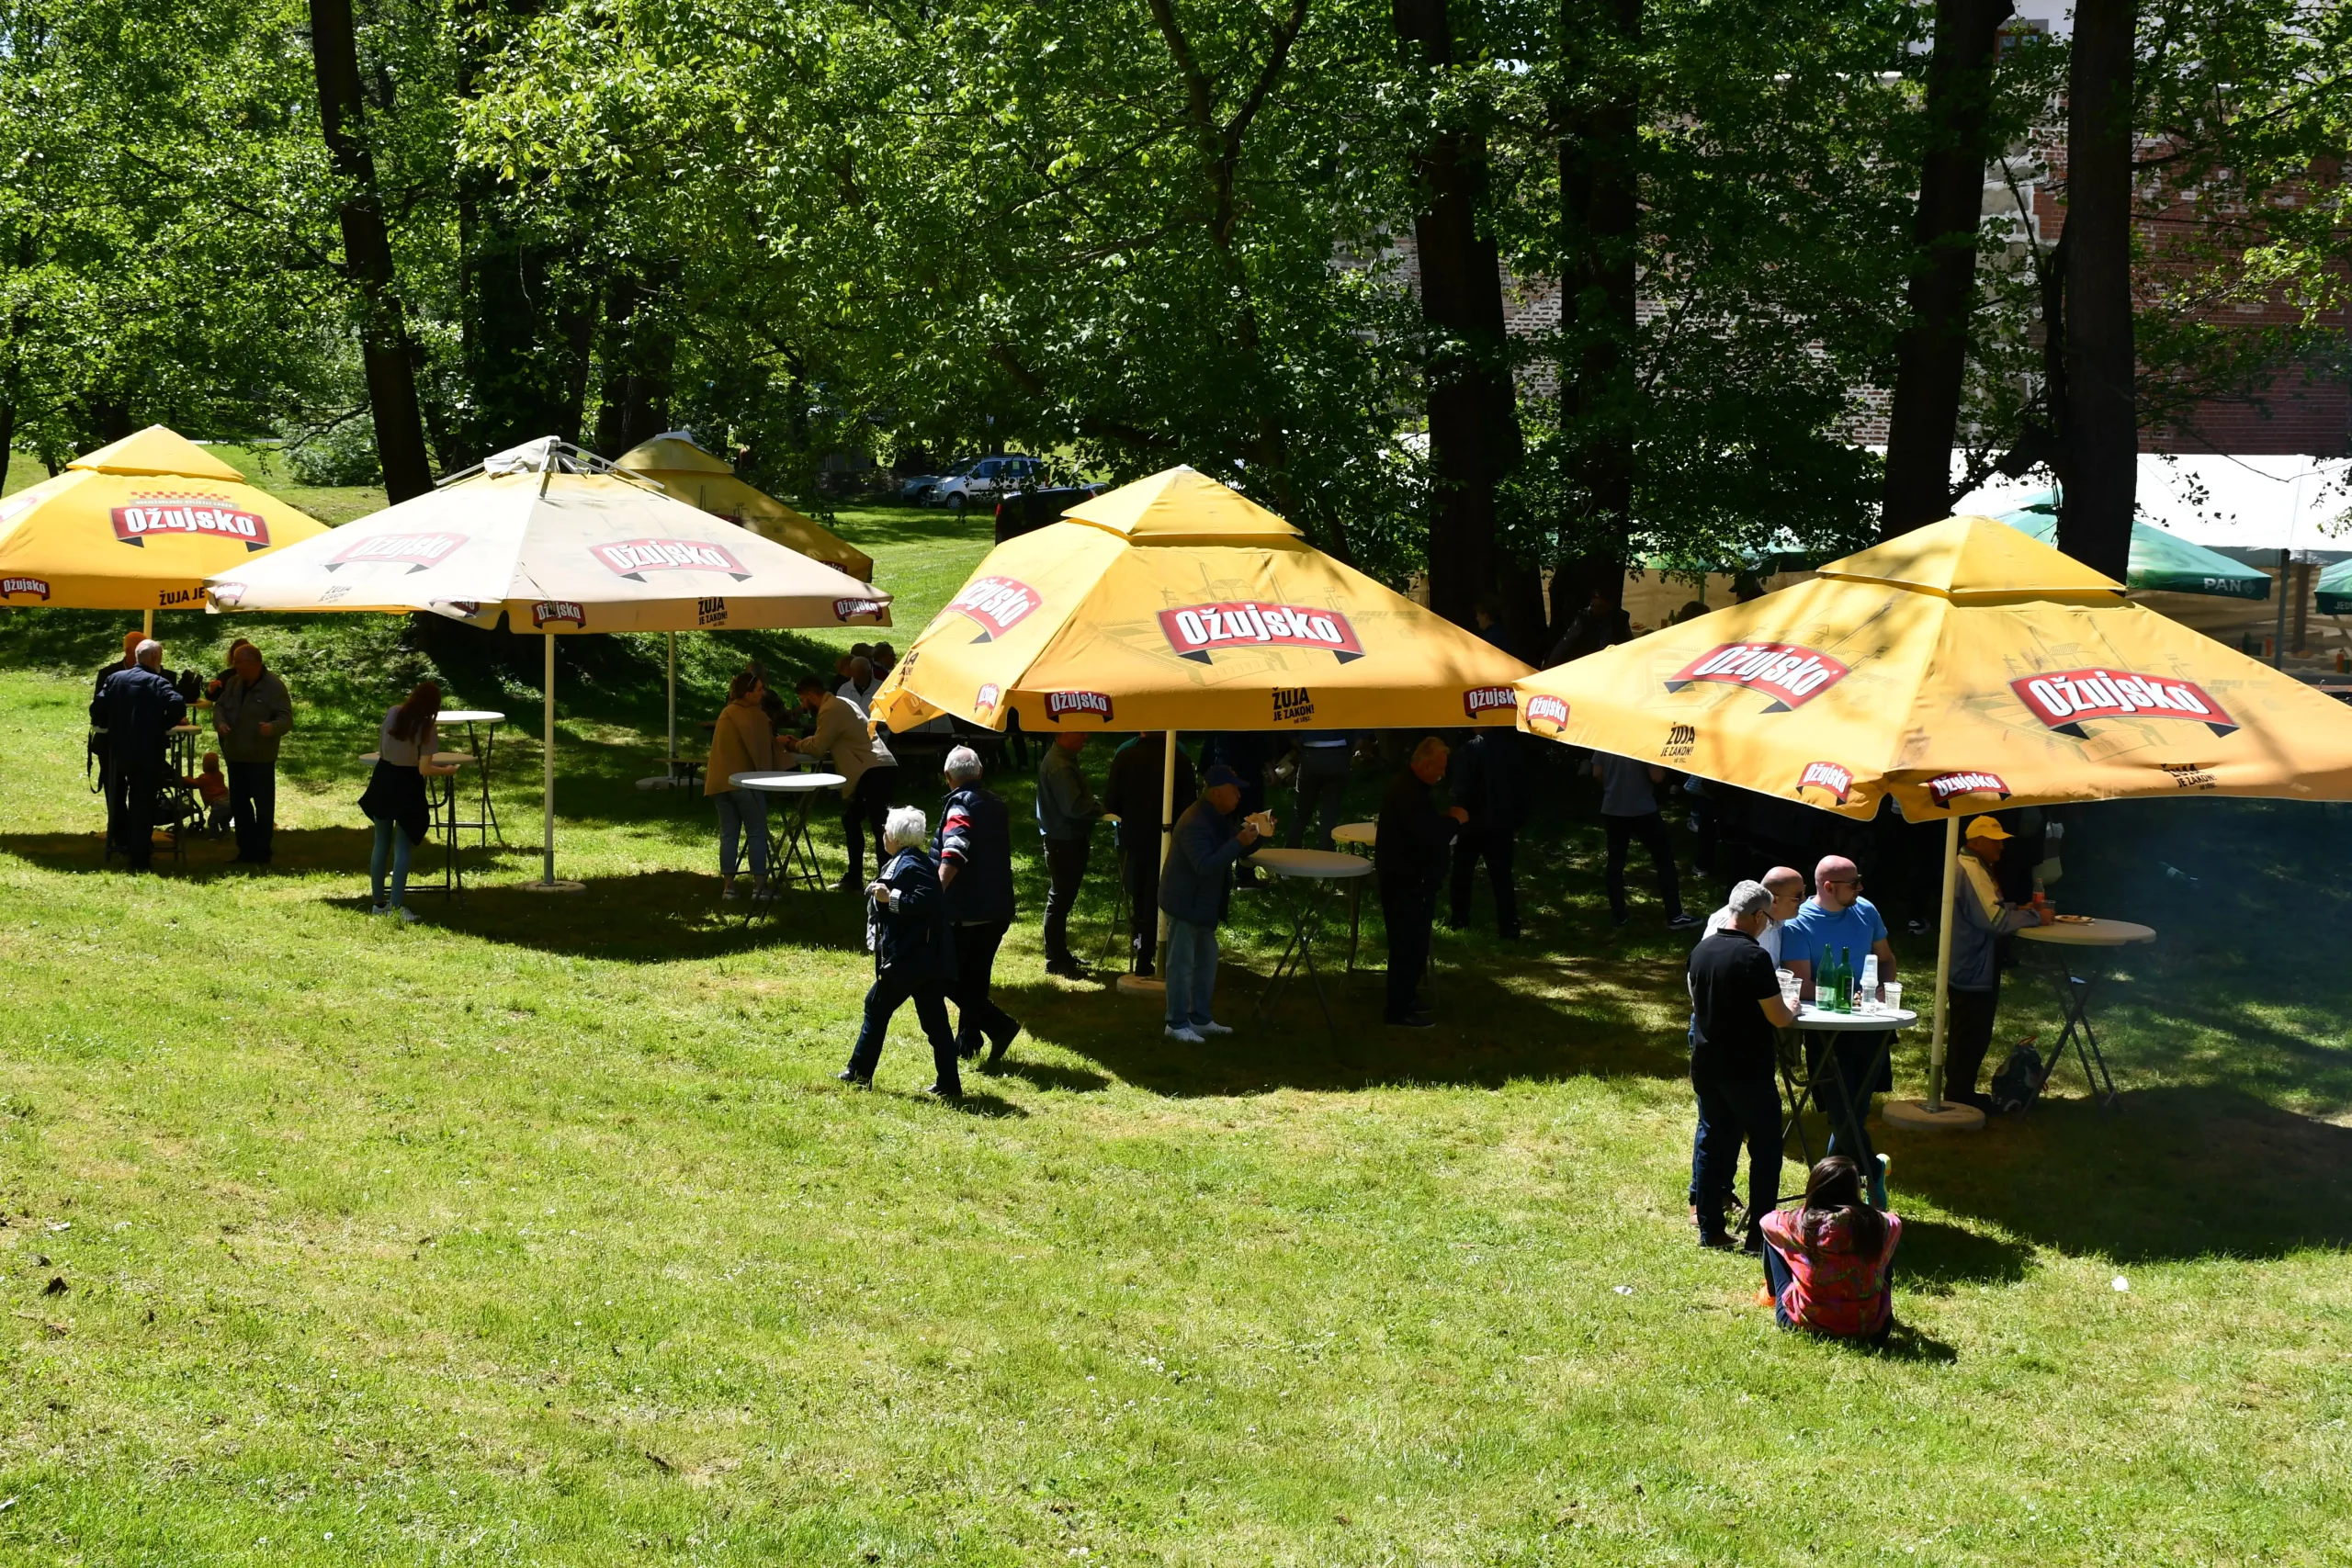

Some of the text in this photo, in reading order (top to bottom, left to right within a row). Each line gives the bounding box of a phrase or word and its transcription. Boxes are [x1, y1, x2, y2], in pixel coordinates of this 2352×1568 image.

[124, 507, 256, 537] Ožujsko
[602, 540, 733, 570] Ožujsko
[4, 579, 46, 593] Ožujsko
[159, 590, 190, 606] ŽUJA
[192, 586, 206, 601] JE
[2203, 578, 2242, 592] PAN
[706, 611, 729, 624] ZAKON!
[837, 599, 879, 615] Ožujsko
[1175, 604, 1345, 645] Ožujsko
[1692, 646, 1831, 696] Ožujsko
[1051, 692, 1108, 713] Ožujsko
[1272, 686, 1310, 711] ŽUJA
[1470, 688, 1516, 710] Ožujsk
[2029, 671, 2211, 716] Ožujsko
[1272, 704, 1316, 722] JE ZAKON!
[1529, 696, 1566, 722] Ožujsko
[1666, 721, 1695, 745] ŽUJA
[1660, 746, 1694, 757] JE ZAKON!
[1804, 763, 1849, 794] Ožujsko
[1934, 772, 2002, 797] Ožujsko
[2176, 777, 2188, 788] JE
[2186, 773, 2218, 785] ZAKON!
